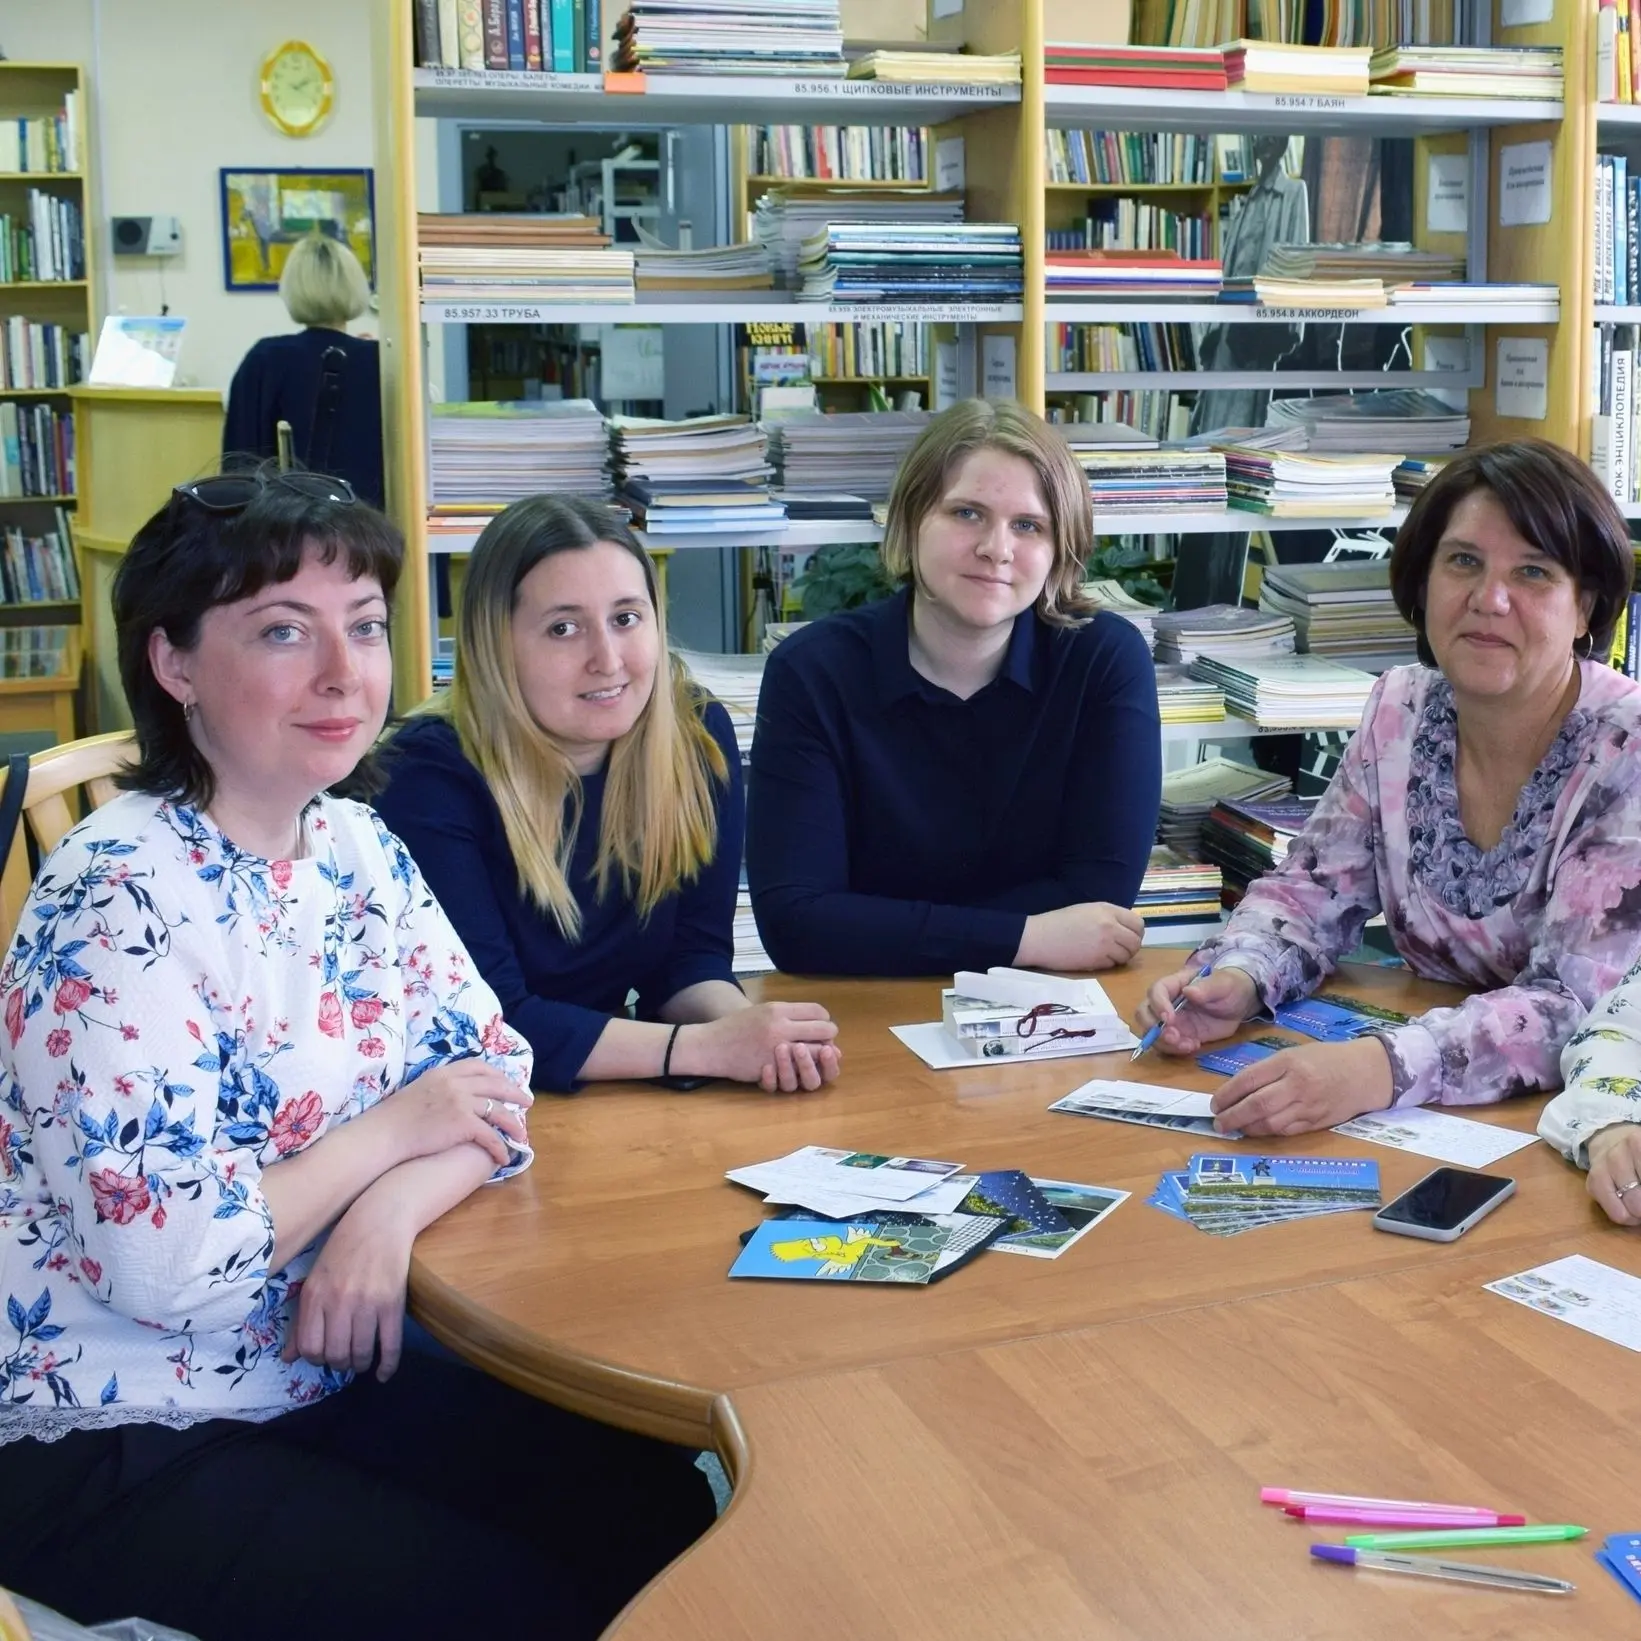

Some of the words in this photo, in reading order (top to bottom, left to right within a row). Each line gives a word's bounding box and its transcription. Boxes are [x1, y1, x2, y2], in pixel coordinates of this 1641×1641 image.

[842, 84, 912, 96] ЩИПКОВЫЕ
[914, 85, 1003, 97] ИНСТРУМЕНТЫ
[1316, 98, 1346, 108] БАЯН
[1628, 189, 1639, 295] АКВАРИУМ
[444, 308, 499, 319] 85.957.33
[501, 308, 541, 319] ТРУБА
[859, 313, 920, 321] МЕХАНИЧЕСКИЕ
[922, 313, 978, 321] ИНСТРУМЕНТЫ
[1256, 308, 1295, 318] 85.954.8
[1297, 308, 1360, 319] АККОРДЕОН
[1615, 358, 1626, 498] РОК-ЭНЦИКЛОПЕДИЯ
